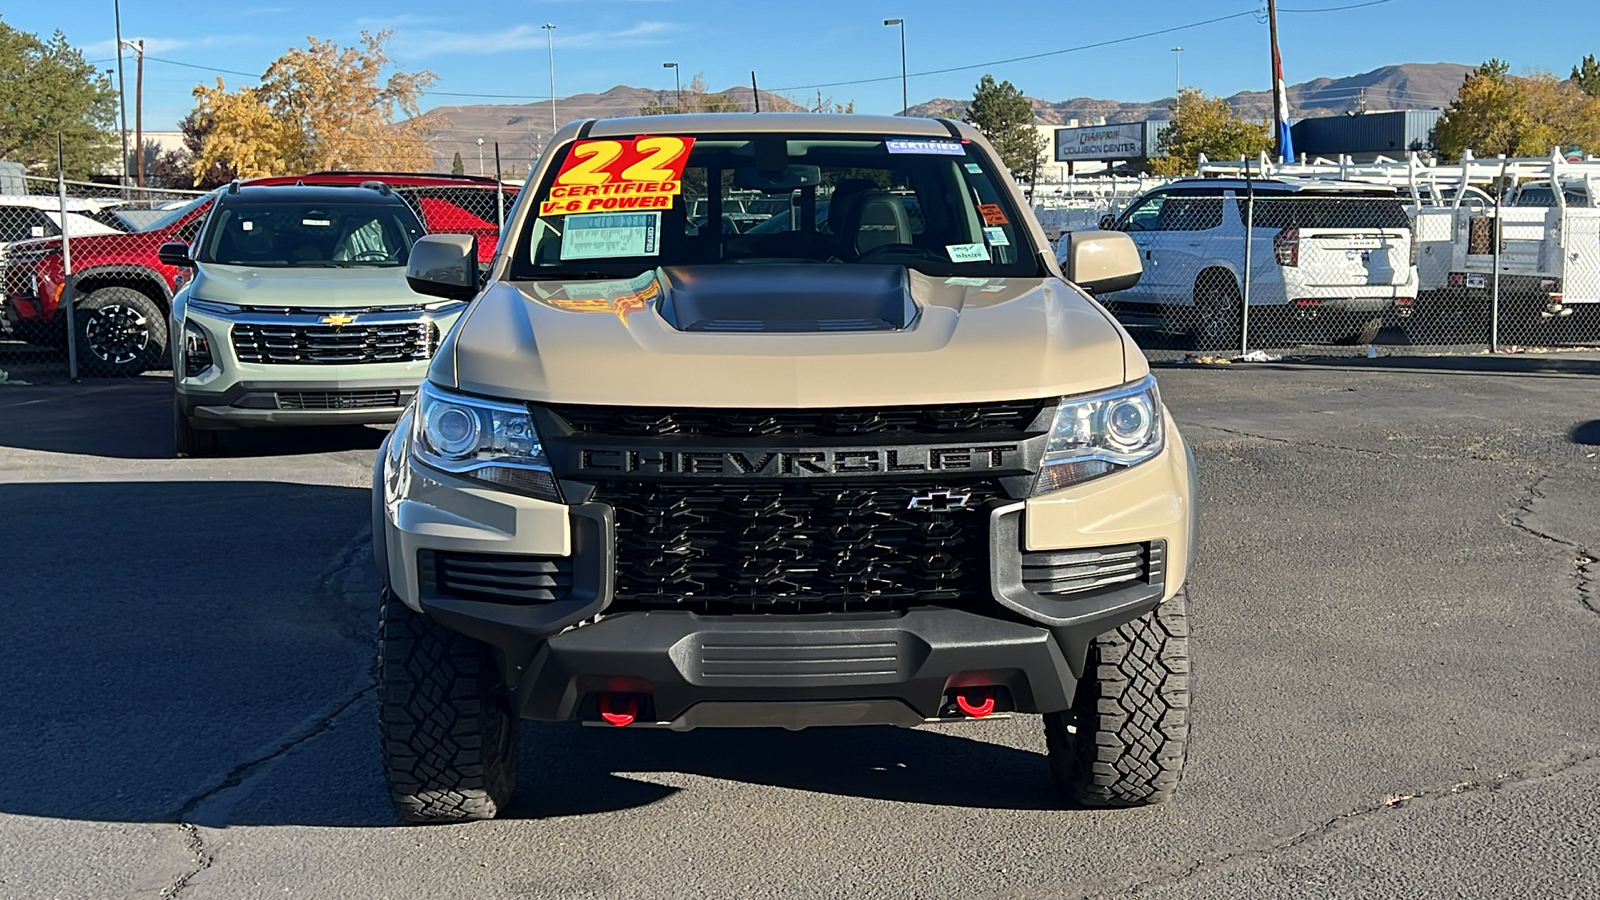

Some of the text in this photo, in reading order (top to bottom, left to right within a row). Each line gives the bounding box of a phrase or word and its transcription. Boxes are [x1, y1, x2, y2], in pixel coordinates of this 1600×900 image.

[890, 142, 960, 150] CERTIFIED
[1080, 131, 1119, 145] CHAMPION
[1064, 143, 1136, 155] COLLISION CENTER
[558, 137, 686, 185] 22
[551, 182, 678, 198] CERTIFIED
[542, 196, 669, 214] V-6 POWER
[578, 444, 1018, 475] CHEVROLET
